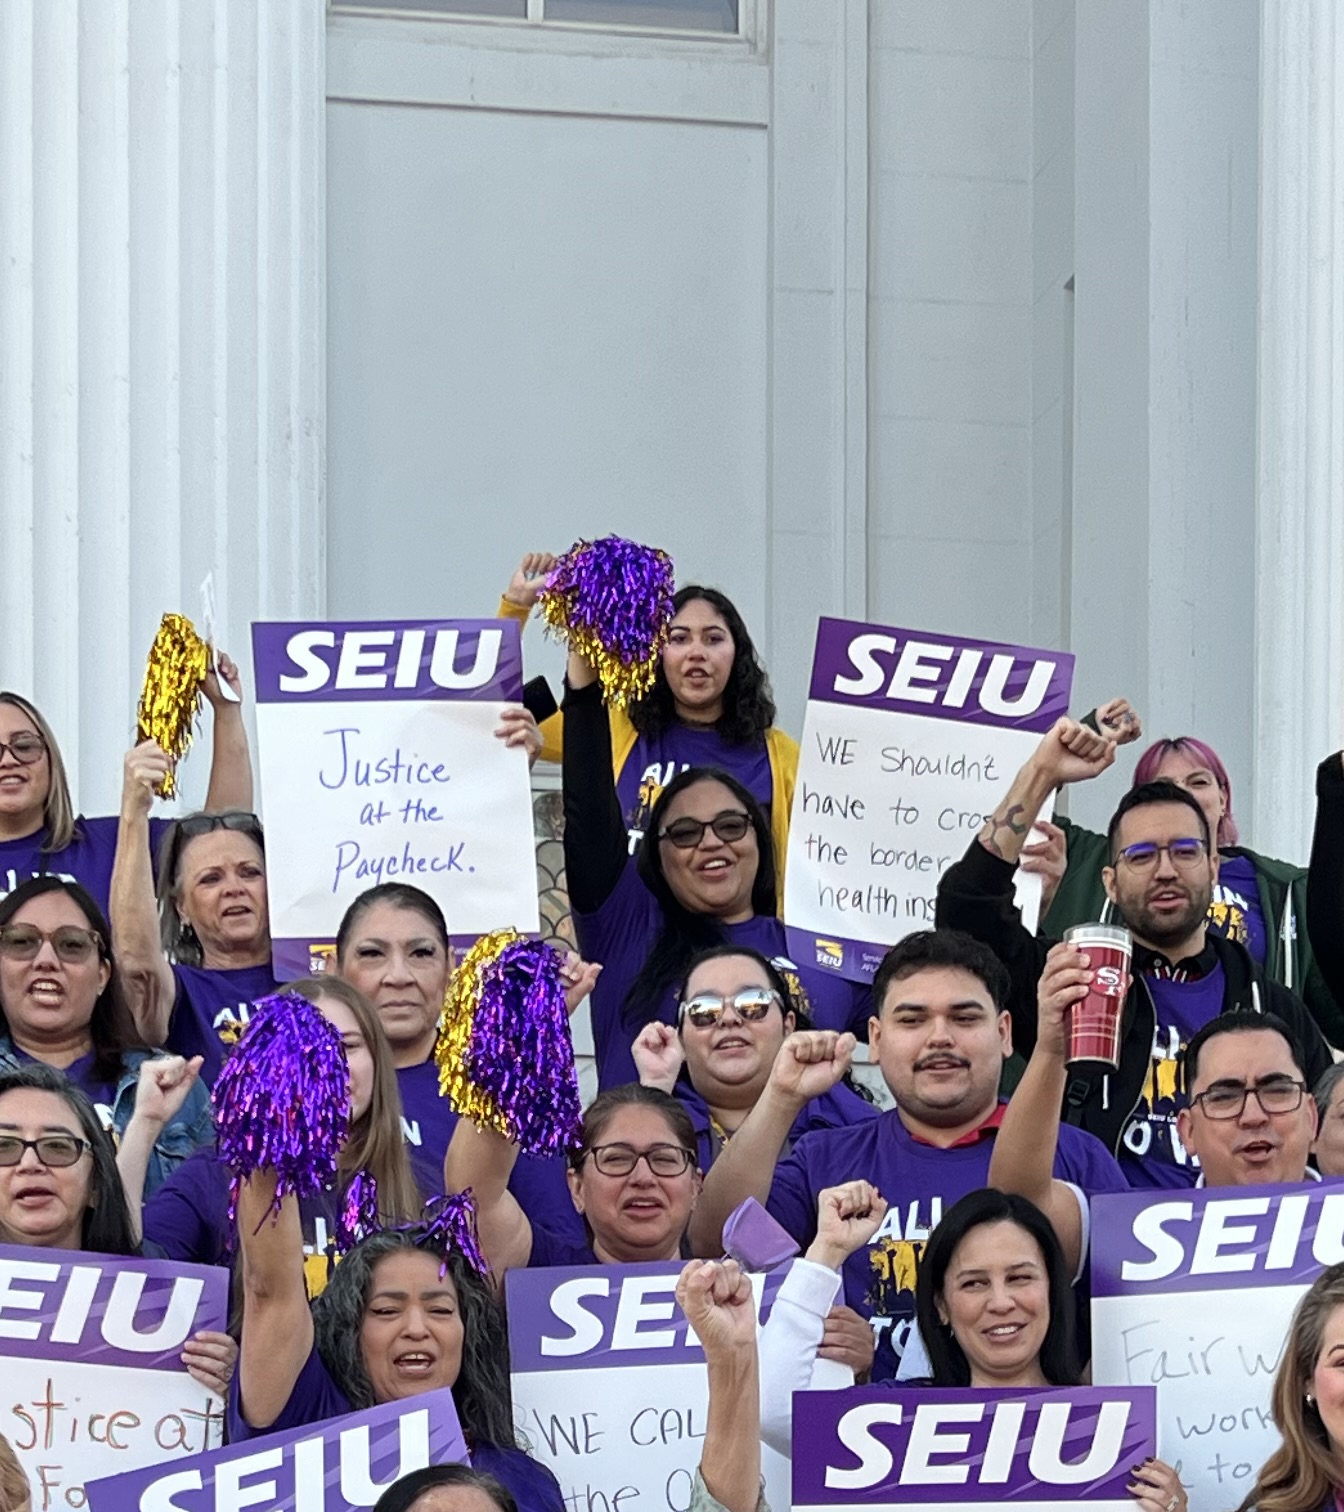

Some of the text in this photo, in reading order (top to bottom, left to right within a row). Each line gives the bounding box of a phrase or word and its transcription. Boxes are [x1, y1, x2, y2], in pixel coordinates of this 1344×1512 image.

[280, 629, 502, 693] SEIU
[834, 634, 1056, 718] SEIU
[319, 728, 451, 789] Justice
[815, 732, 858, 766] WE
[360, 799, 444, 826] at the
[803, 783, 919, 825] have to
[804, 833, 950, 874] the border
[818, 878, 897, 916] health
[817, 954, 843, 967] SEIU
[1121, 1320, 1225, 1385] Fair
[533, 1408, 605, 1456] WE
[824, 1401, 1131, 1490] SEIU
[1208, 1453, 1252, 1484] to
